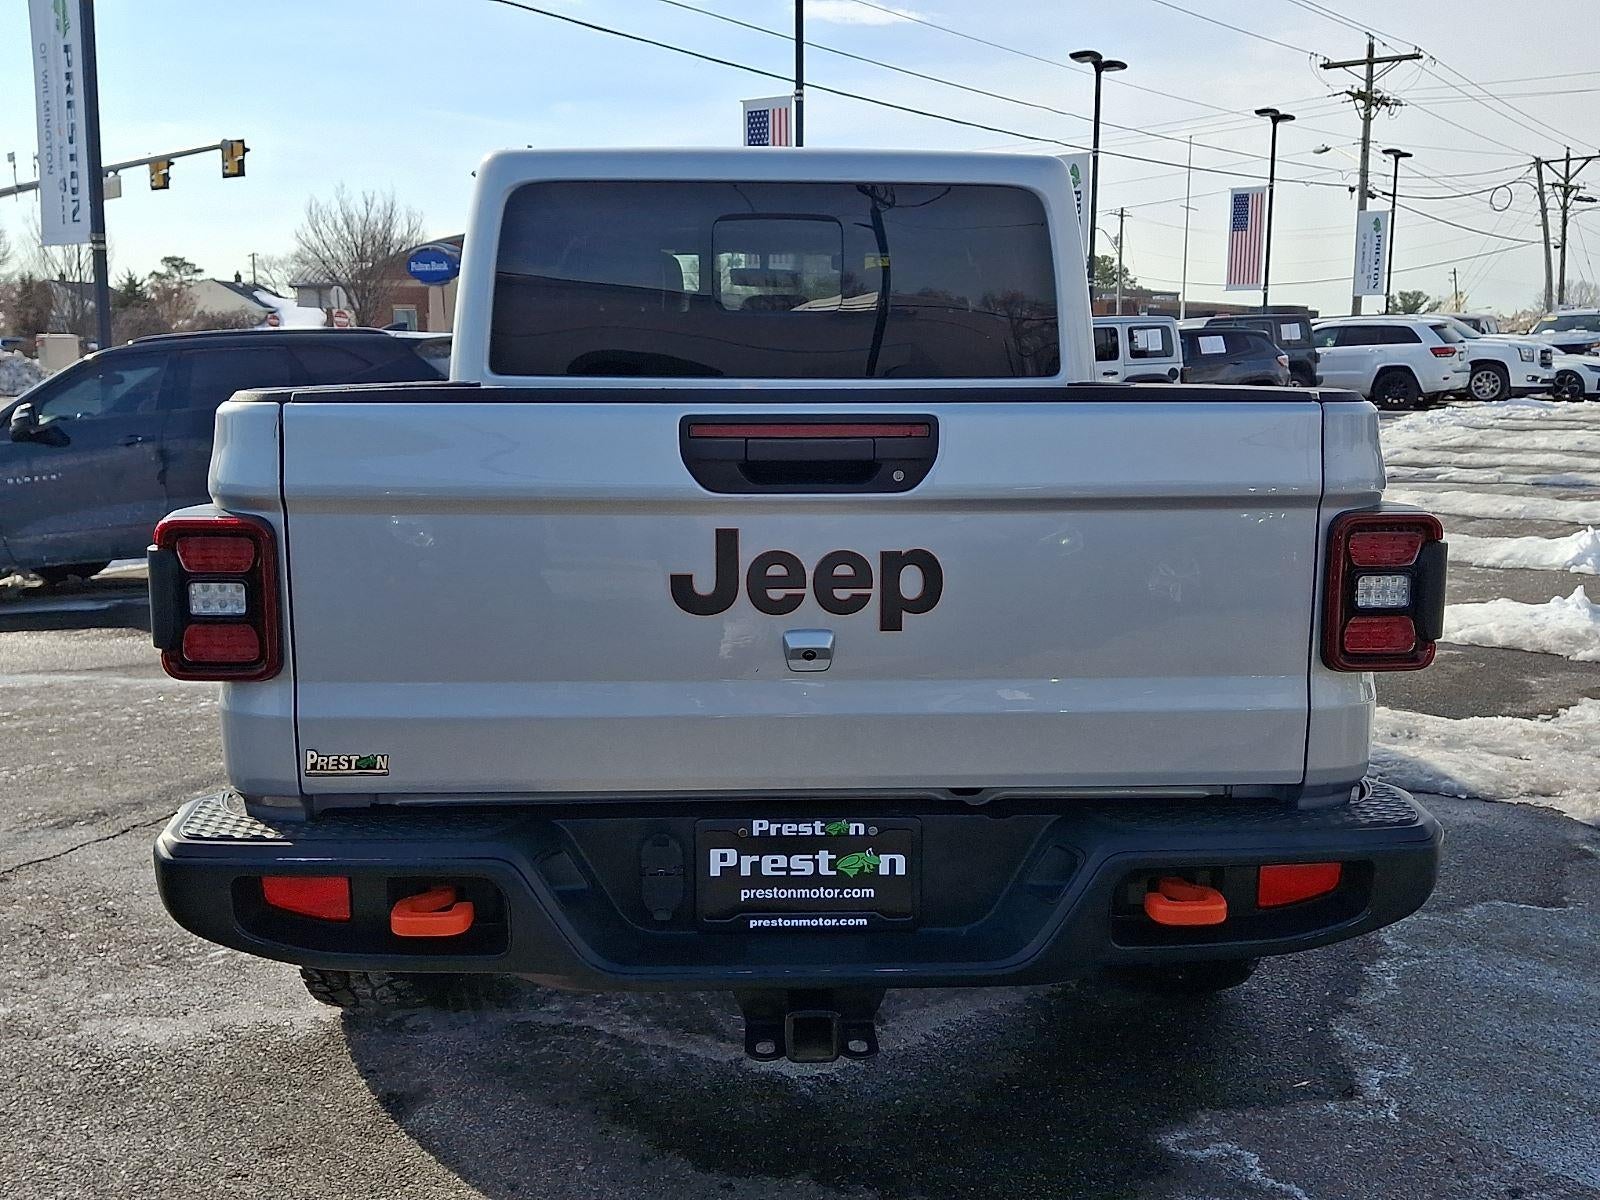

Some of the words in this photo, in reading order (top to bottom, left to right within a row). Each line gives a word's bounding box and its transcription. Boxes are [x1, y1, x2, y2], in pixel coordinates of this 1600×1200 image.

[42, 68, 54, 175] WILMINGTON
[63, 43, 81, 223] PRESTON
[1373, 234, 1382, 289] PRESTON
[670, 528, 943, 631] Jeep
[740, 886, 875, 901] prestonmotor.com
[749, 916, 868, 928] prestonmotor.com
